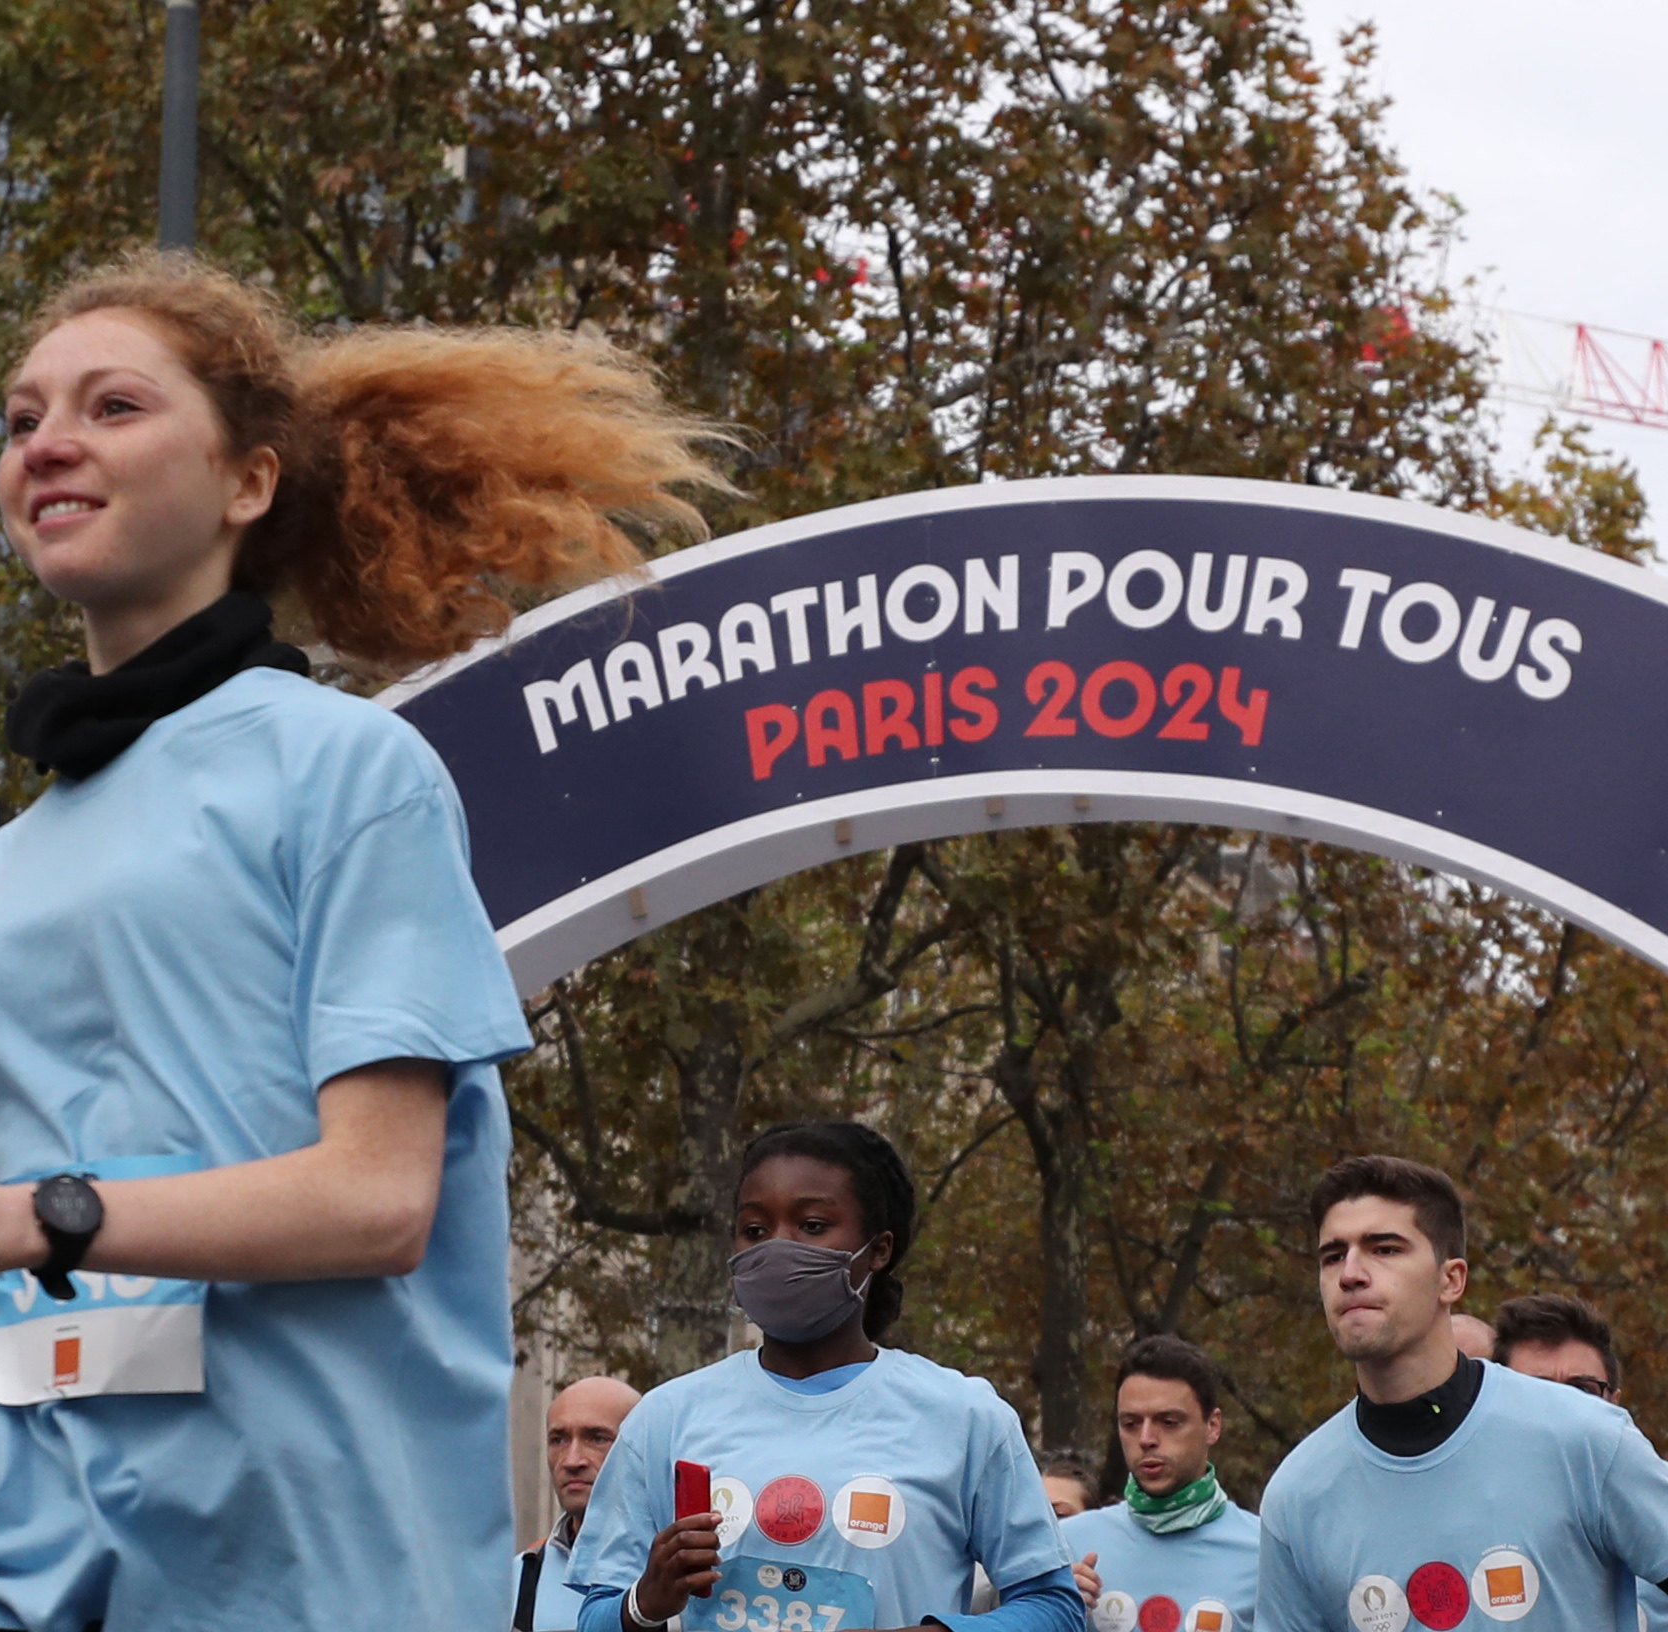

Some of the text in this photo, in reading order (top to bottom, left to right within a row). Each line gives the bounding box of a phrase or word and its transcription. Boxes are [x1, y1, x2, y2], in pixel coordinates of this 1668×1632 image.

[522, 549, 1583, 754] MARATHON POUR TOUS
[744, 659, 1271, 781] PARIS 2024
[849, 1519, 885, 1532] orange
[1490, 1592, 1524, 1605] orange
